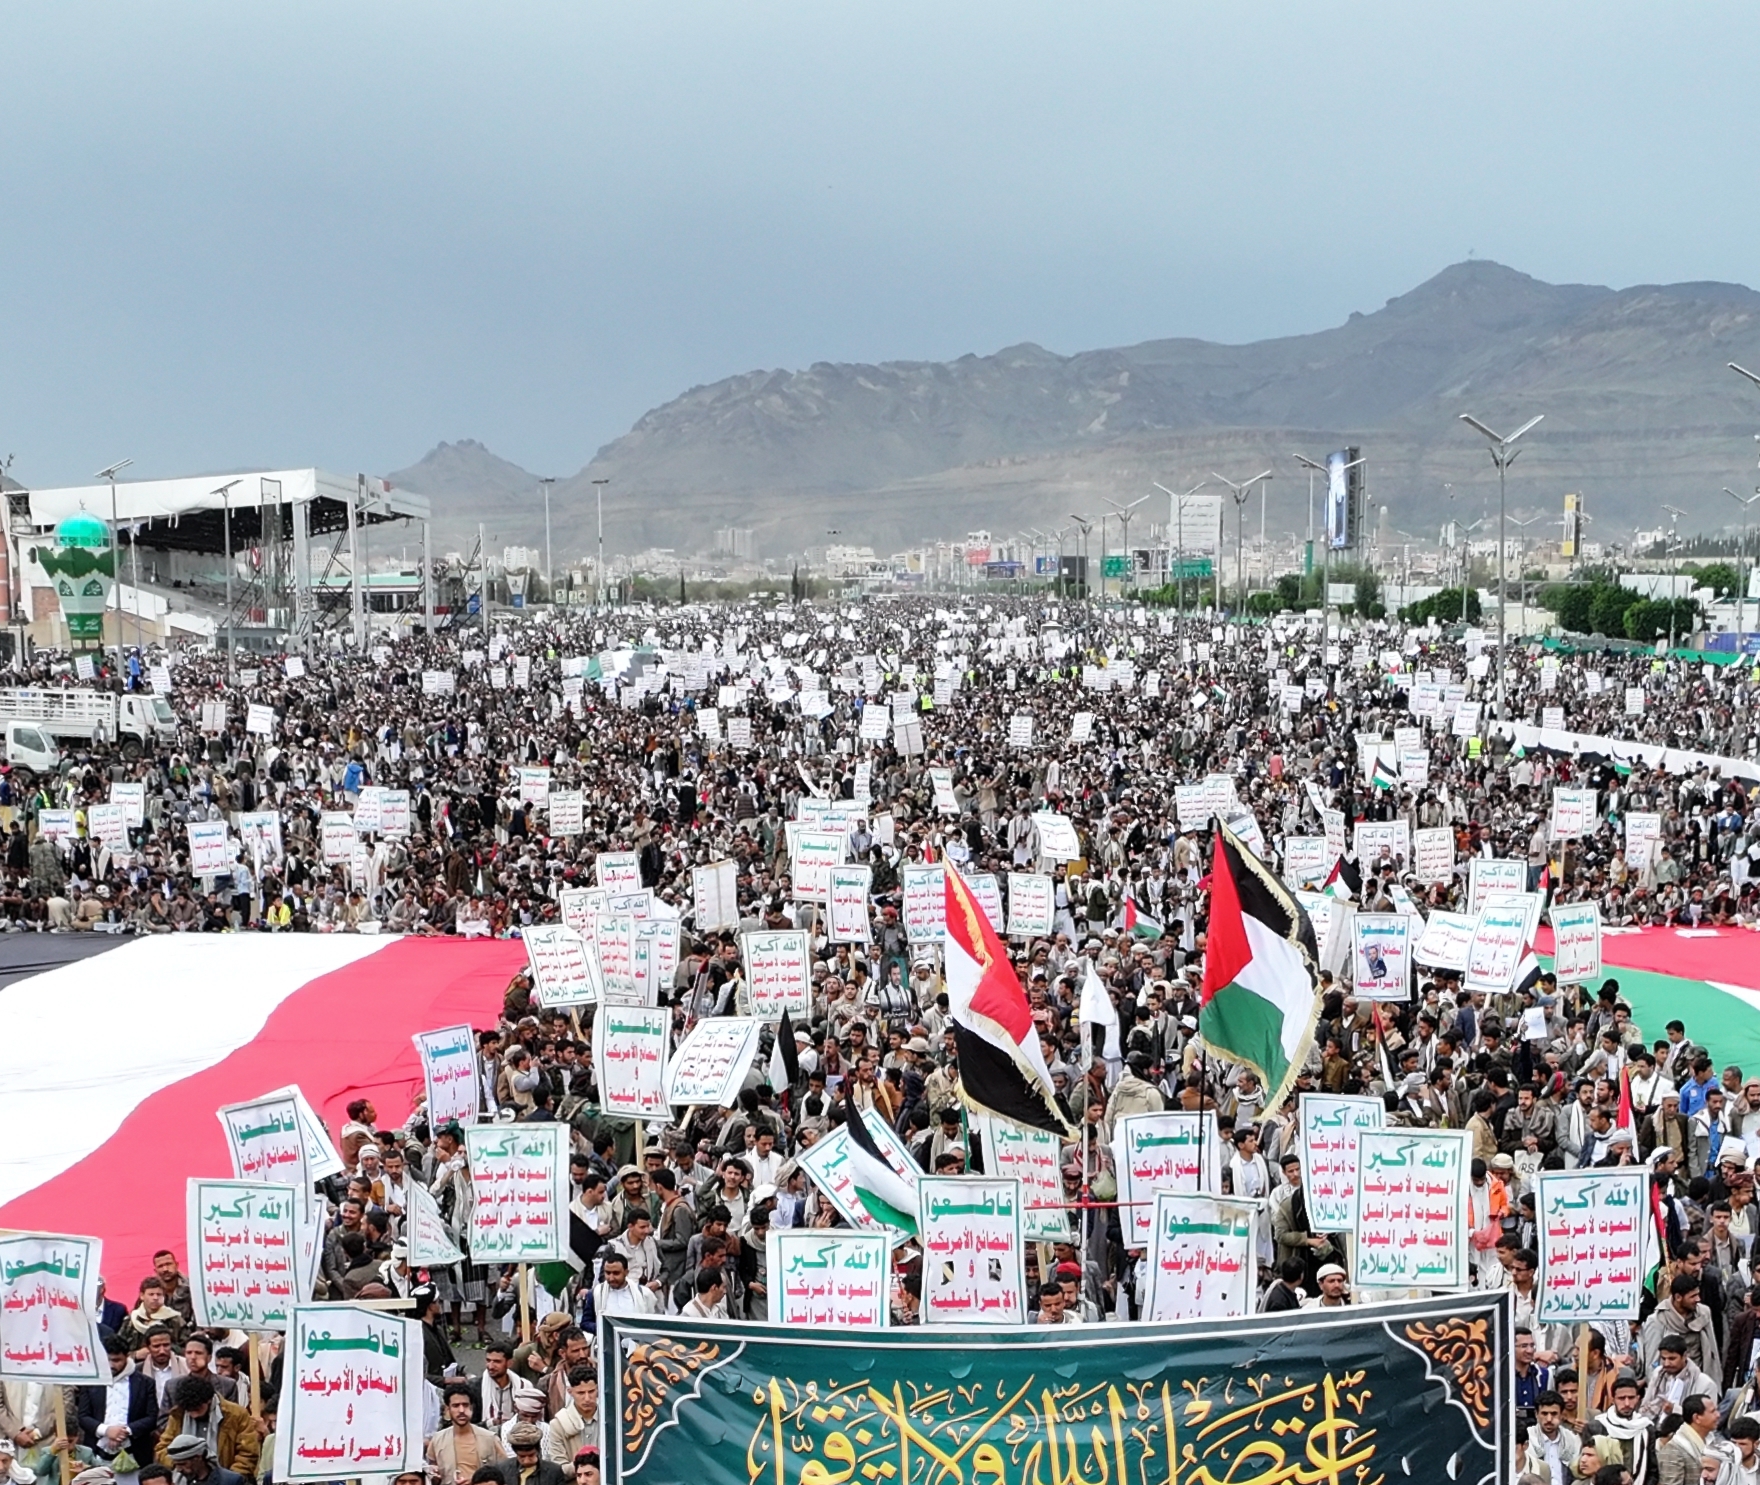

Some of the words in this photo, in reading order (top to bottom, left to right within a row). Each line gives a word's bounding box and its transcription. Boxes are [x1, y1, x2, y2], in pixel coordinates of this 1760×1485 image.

[474, 1132, 520, 1163] أكبر
[522, 1134, 552, 1157] الله
[1364, 1139, 1418, 1171] أكبر
[1421, 1138, 1456, 1168] الله
[518, 1166, 551, 1181] الموت
[518, 1190, 551, 1205] الموت
[1415, 1179, 1454, 1195] الموت
[1547, 1180, 1601, 1215] أكبر
[1603, 1182, 1638, 1206] الله
[925, 1190, 1012, 1222] قاطعوا
[1415, 1206, 1453, 1221] الموت
[474, 1212, 502, 1229] اليهود
[506, 1211, 521, 1228] على
[526, 1210, 553, 1226] اللعنة
[1599, 1217, 1637, 1235] الموت
[473, 1229, 513, 1258] للإسلام
[517, 1230, 553, 1255] النصر
[927, 1226, 972, 1256] الأمريكية
[976, 1231, 1012, 1253] البضائع
[1361, 1229, 1395, 1248] اليهود
[1399, 1229, 1419, 1248] على
[1423, 1230, 1453, 1247] اللعنة
[1599, 1242, 1637, 1258] الموت
[968, 1259, 974, 1278] و
[1360, 1251, 1408, 1280] للإسلام
[1412, 1250, 1454, 1278] النصر
[1607, 1267, 1637, 1284] اللعنة
[1546, 1271, 1580, 1288] اليهود
[1584, 1268, 1603, 1287] على
[4, 1282, 46, 1313] الأمريكية
[930, 1289, 1016, 1313] الإسرائيلية
[1543, 1293, 1591, 1319] للإسلام
[1594, 1290, 1636, 1315] النصر
[42, 1314, 49, 1332] و
[301, 1323, 399, 1359] قاطعوا
[5, 1341, 91, 1367] الإسرائيلية
[299, 1363, 354, 1397] الأمريكية
[356, 1365, 398, 1398] البضائع
[346, 1403, 353, 1425] و
[297, 1435, 401, 1463] الإسرائيلية
